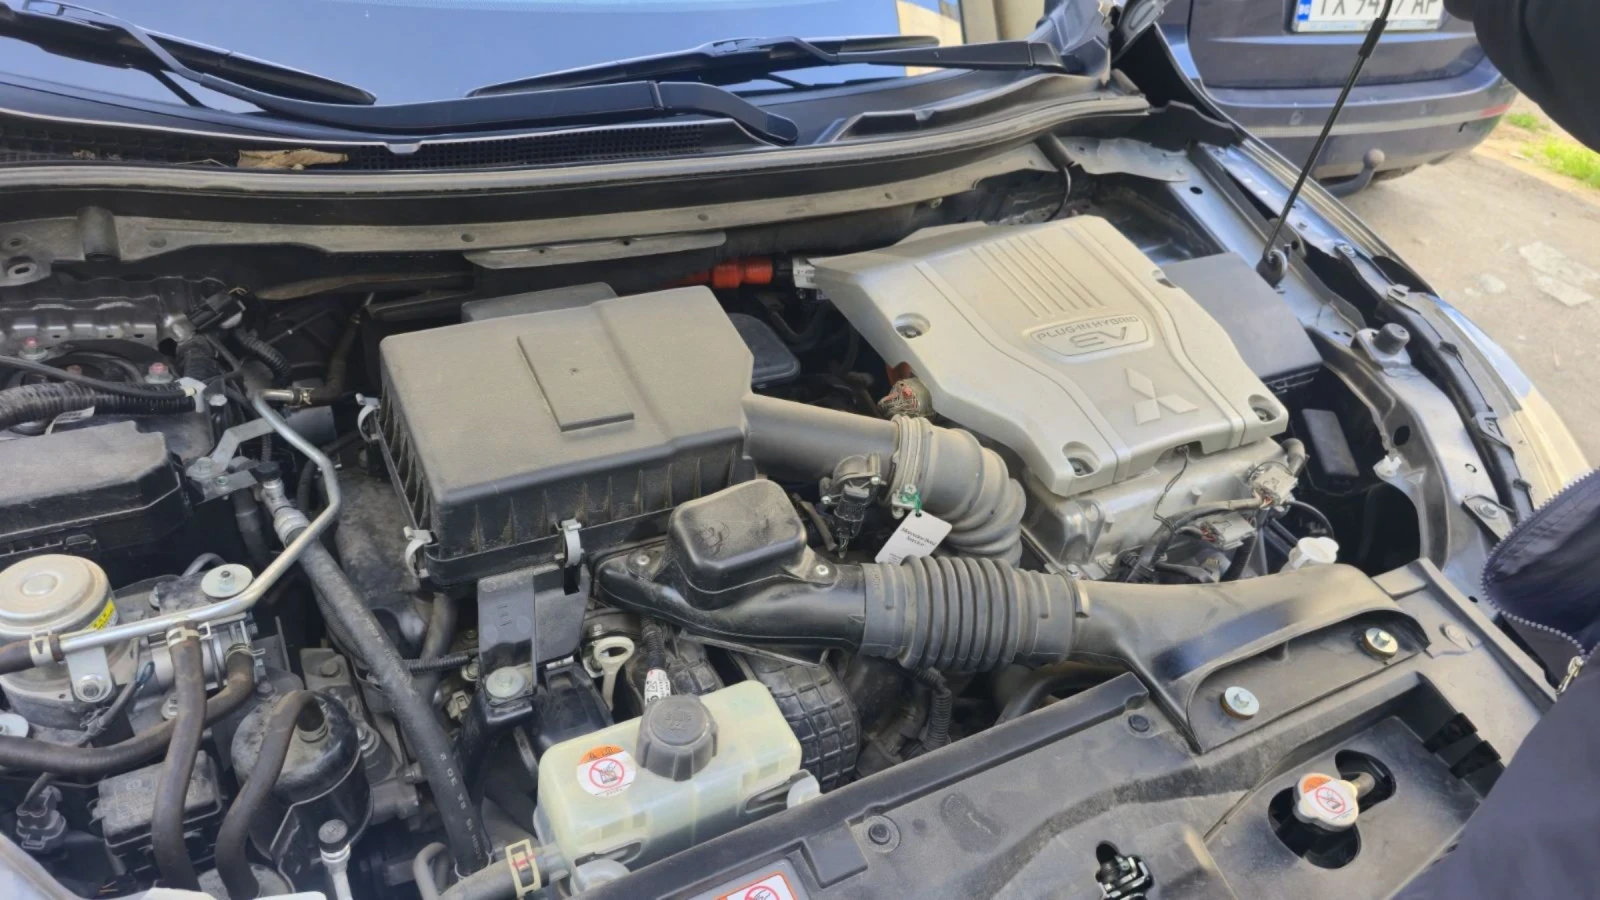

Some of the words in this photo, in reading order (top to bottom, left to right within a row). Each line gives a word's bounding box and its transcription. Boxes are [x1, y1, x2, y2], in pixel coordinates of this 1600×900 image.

[1036, 321, 1091, 341] PLUG-IN
[1091, 316, 1139, 330] HYBRID
[1069, 326, 1127, 349] EV
